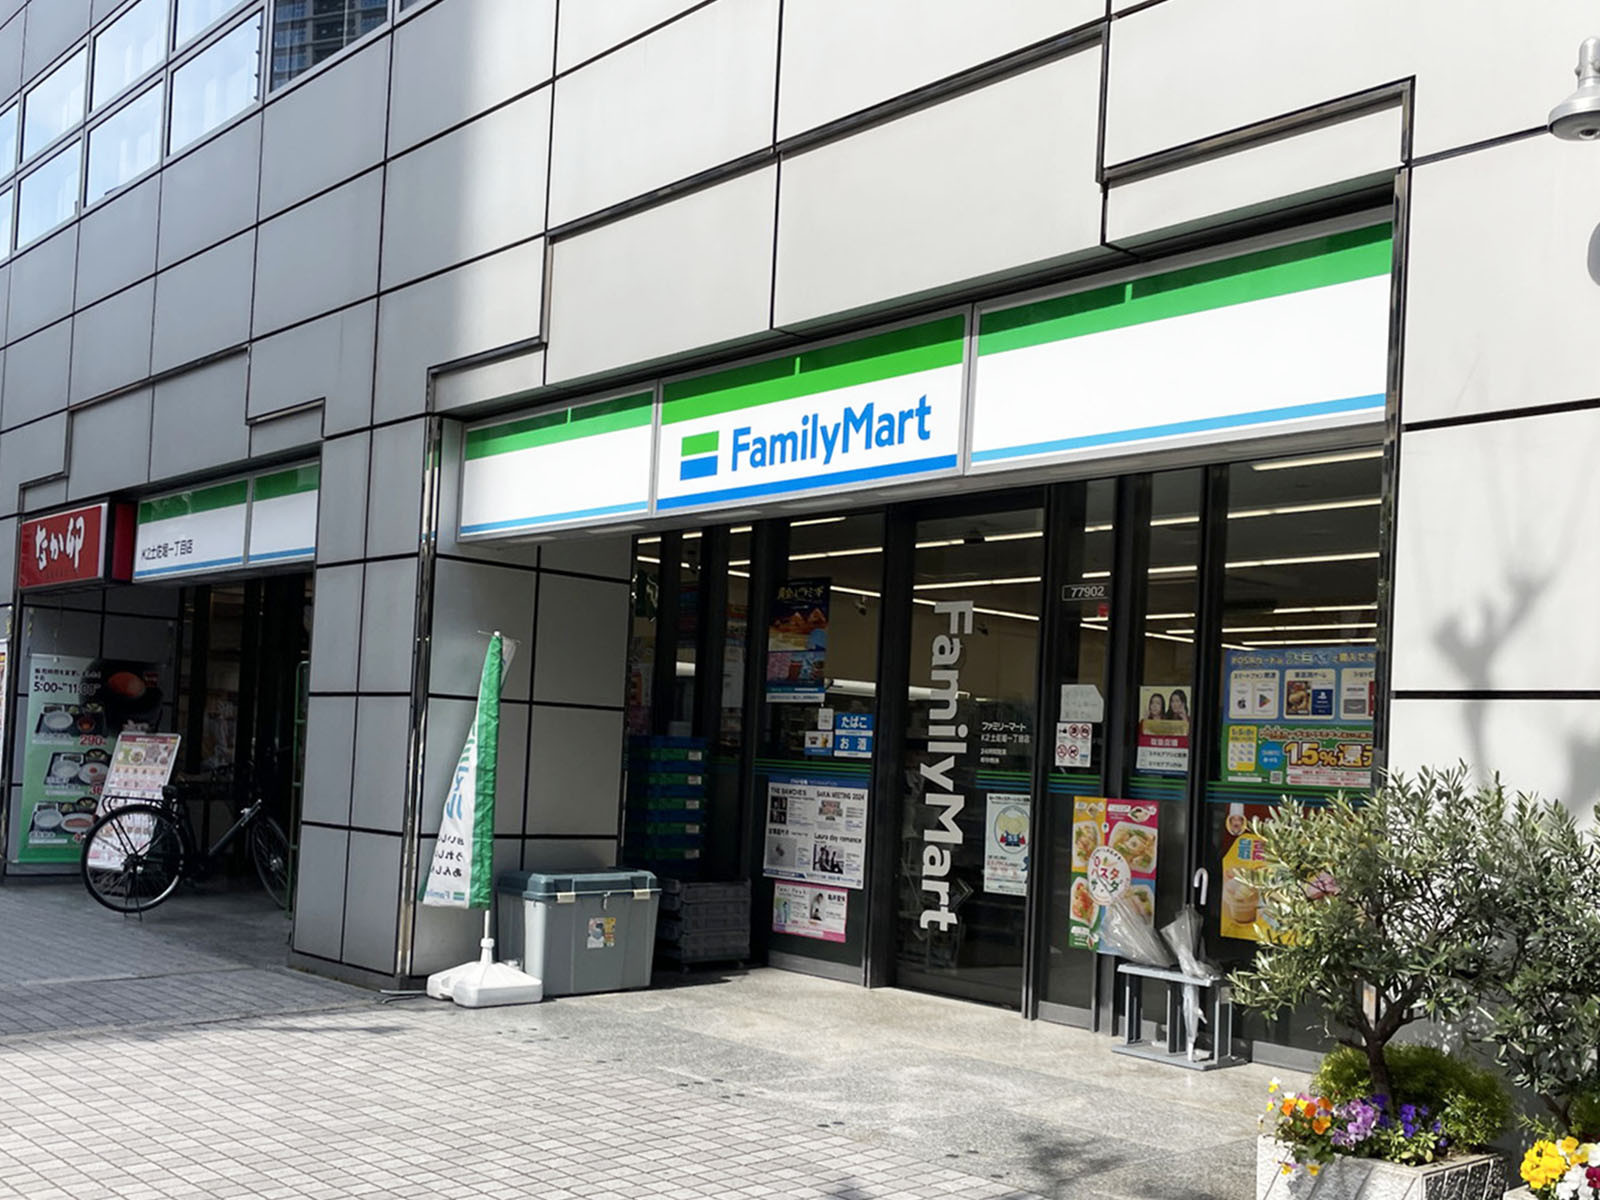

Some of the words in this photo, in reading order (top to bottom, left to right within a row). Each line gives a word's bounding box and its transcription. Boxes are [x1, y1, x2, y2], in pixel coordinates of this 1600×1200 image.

[731, 394, 932, 472] FamilyMart
[35, 516, 85, 571] なか卯
[1071, 586, 1105, 598] 77902
[841, 715, 868, 729] たばこ
[982, 721, 1027, 732] ファミリーマート
[919, 601, 974, 932] FamilyMart
[814, 832, 829, 840] Laura
[840, 836, 862, 844] romance
